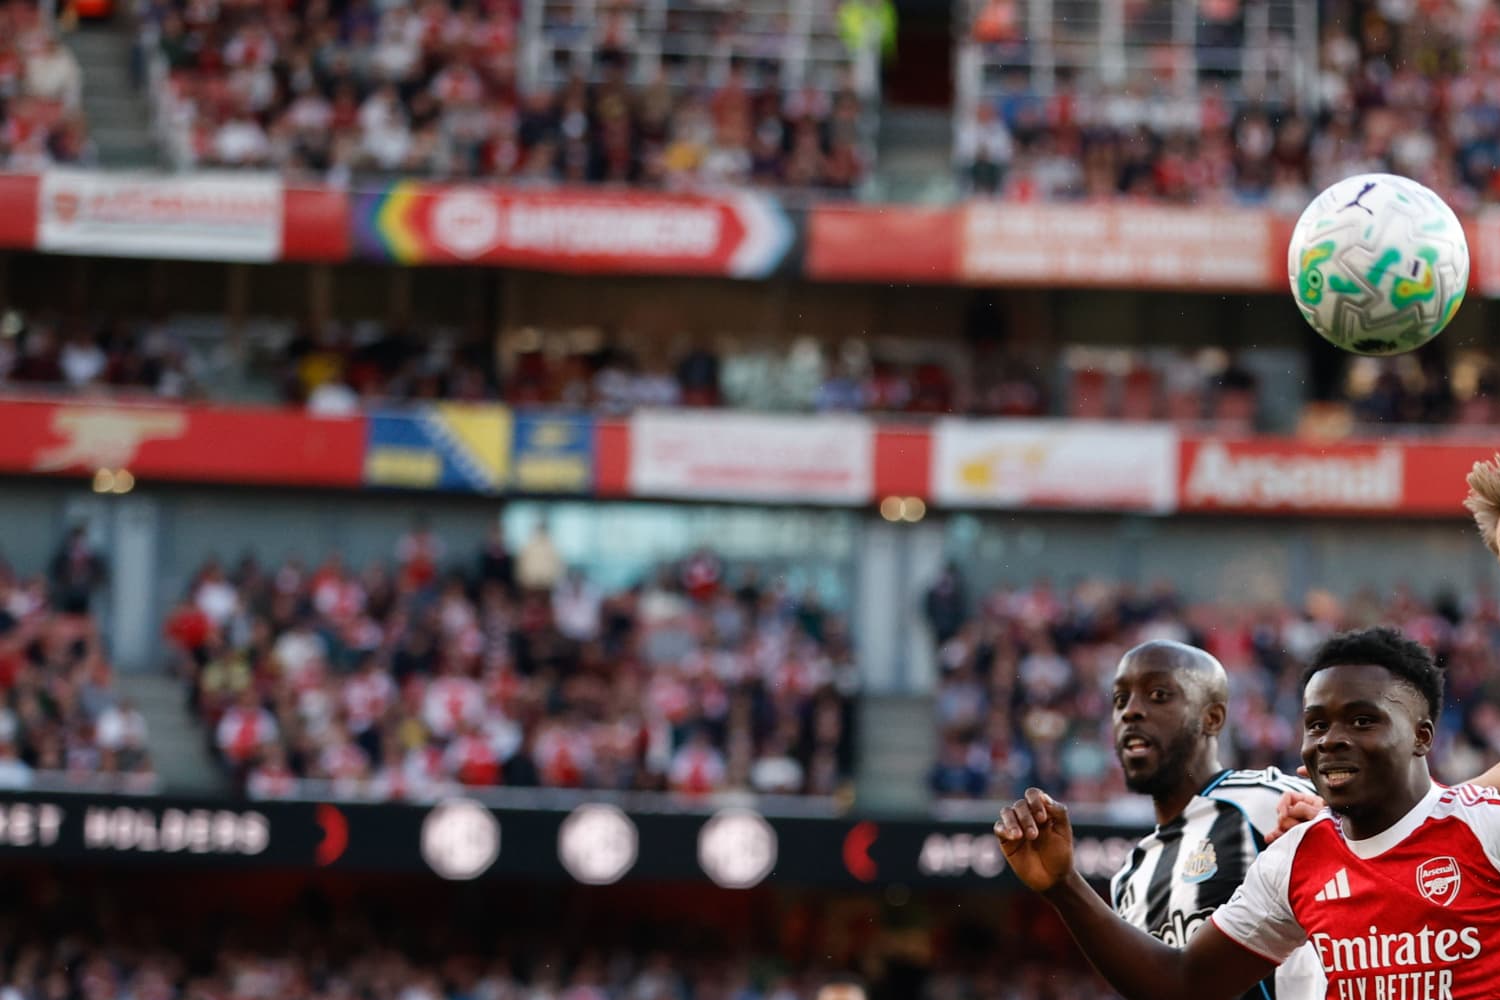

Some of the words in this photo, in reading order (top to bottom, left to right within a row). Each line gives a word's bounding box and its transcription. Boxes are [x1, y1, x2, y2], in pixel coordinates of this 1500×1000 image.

[1189, 442, 1401, 508] Arsenal
[84, 805, 271, 856] HOLDERS
[1423, 863, 1454, 878] Arsenal
[1312, 924, 1482, 973] Emirates
